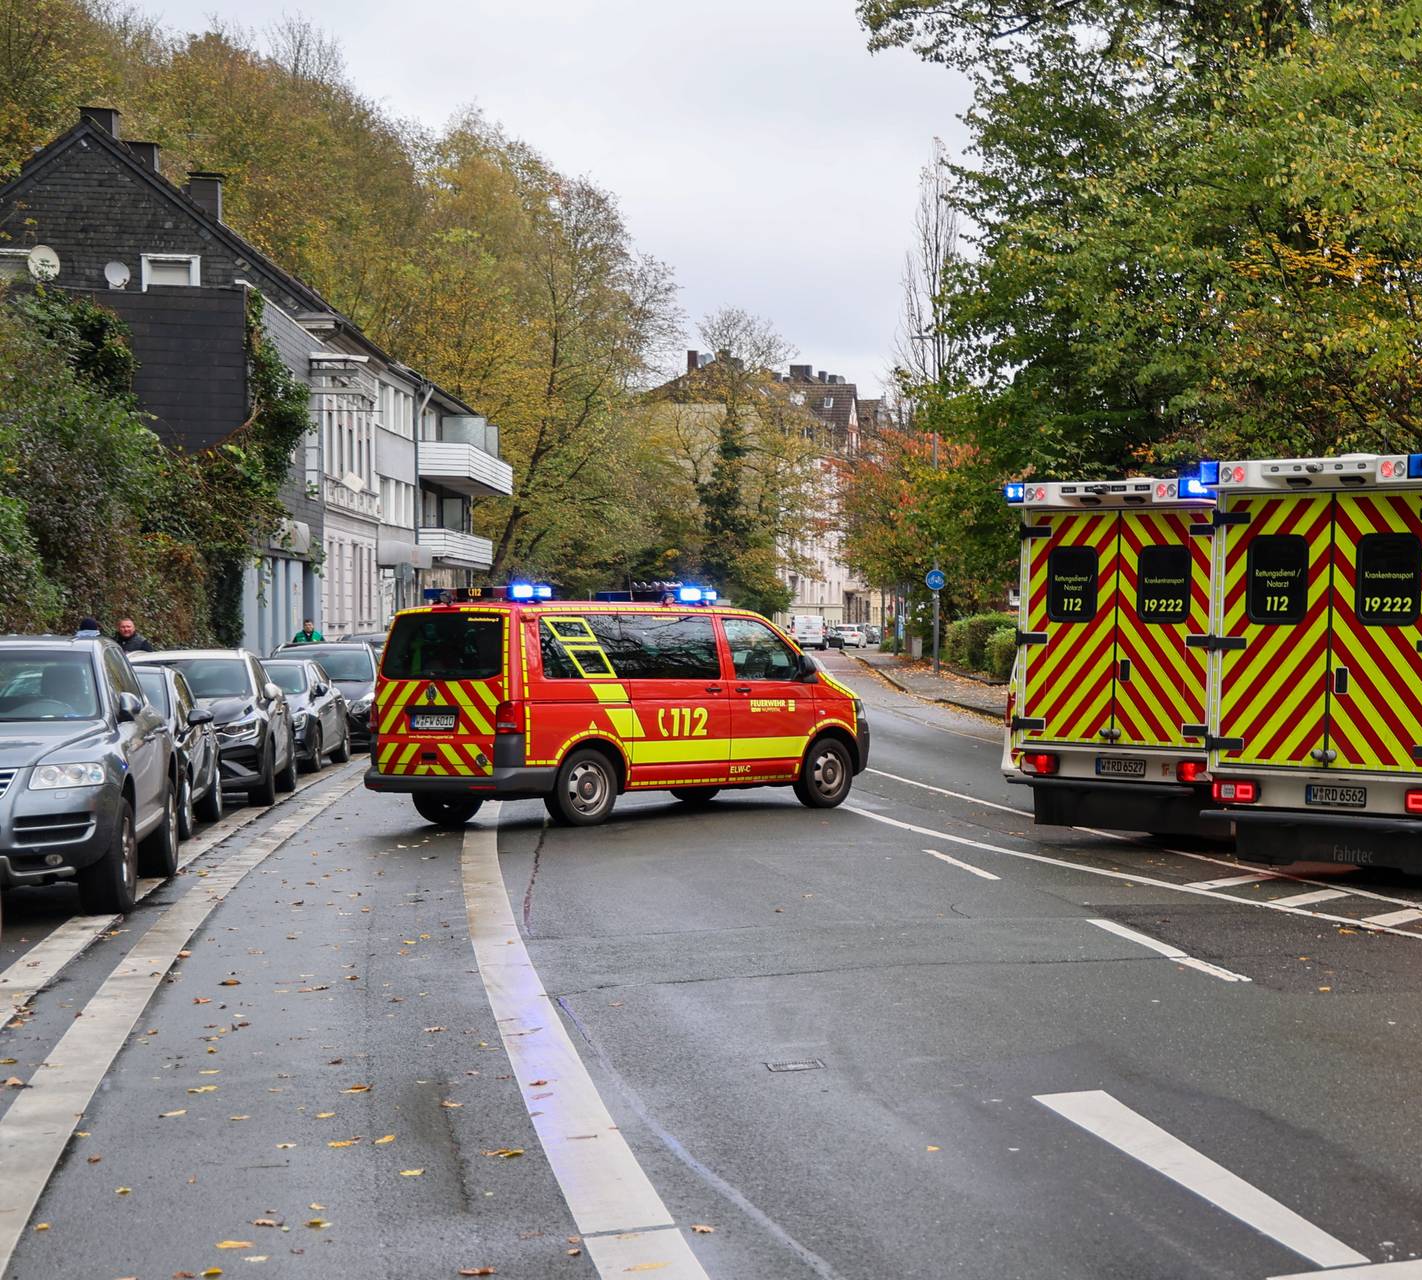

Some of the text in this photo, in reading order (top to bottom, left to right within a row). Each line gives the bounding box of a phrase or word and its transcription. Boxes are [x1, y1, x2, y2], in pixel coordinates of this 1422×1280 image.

[1255, 569, 1296, 579] Rettungsdienst
[1364, 571, 1414, 580] Krankentransport
[1144, 577, 1185, 585] Krankentransport
[1266, 580, 1290, 588] Notarzt
[1063, 598, 1082, 611] 112
[1265, 596, 1289, 612] 112
[750, 699, 786, 707] FEUERWEHR
[670, 707, 709, 737] 112
[730, 765, 752, 774] ELW-C
[1333, 844, 1374, 863] fahrtec
